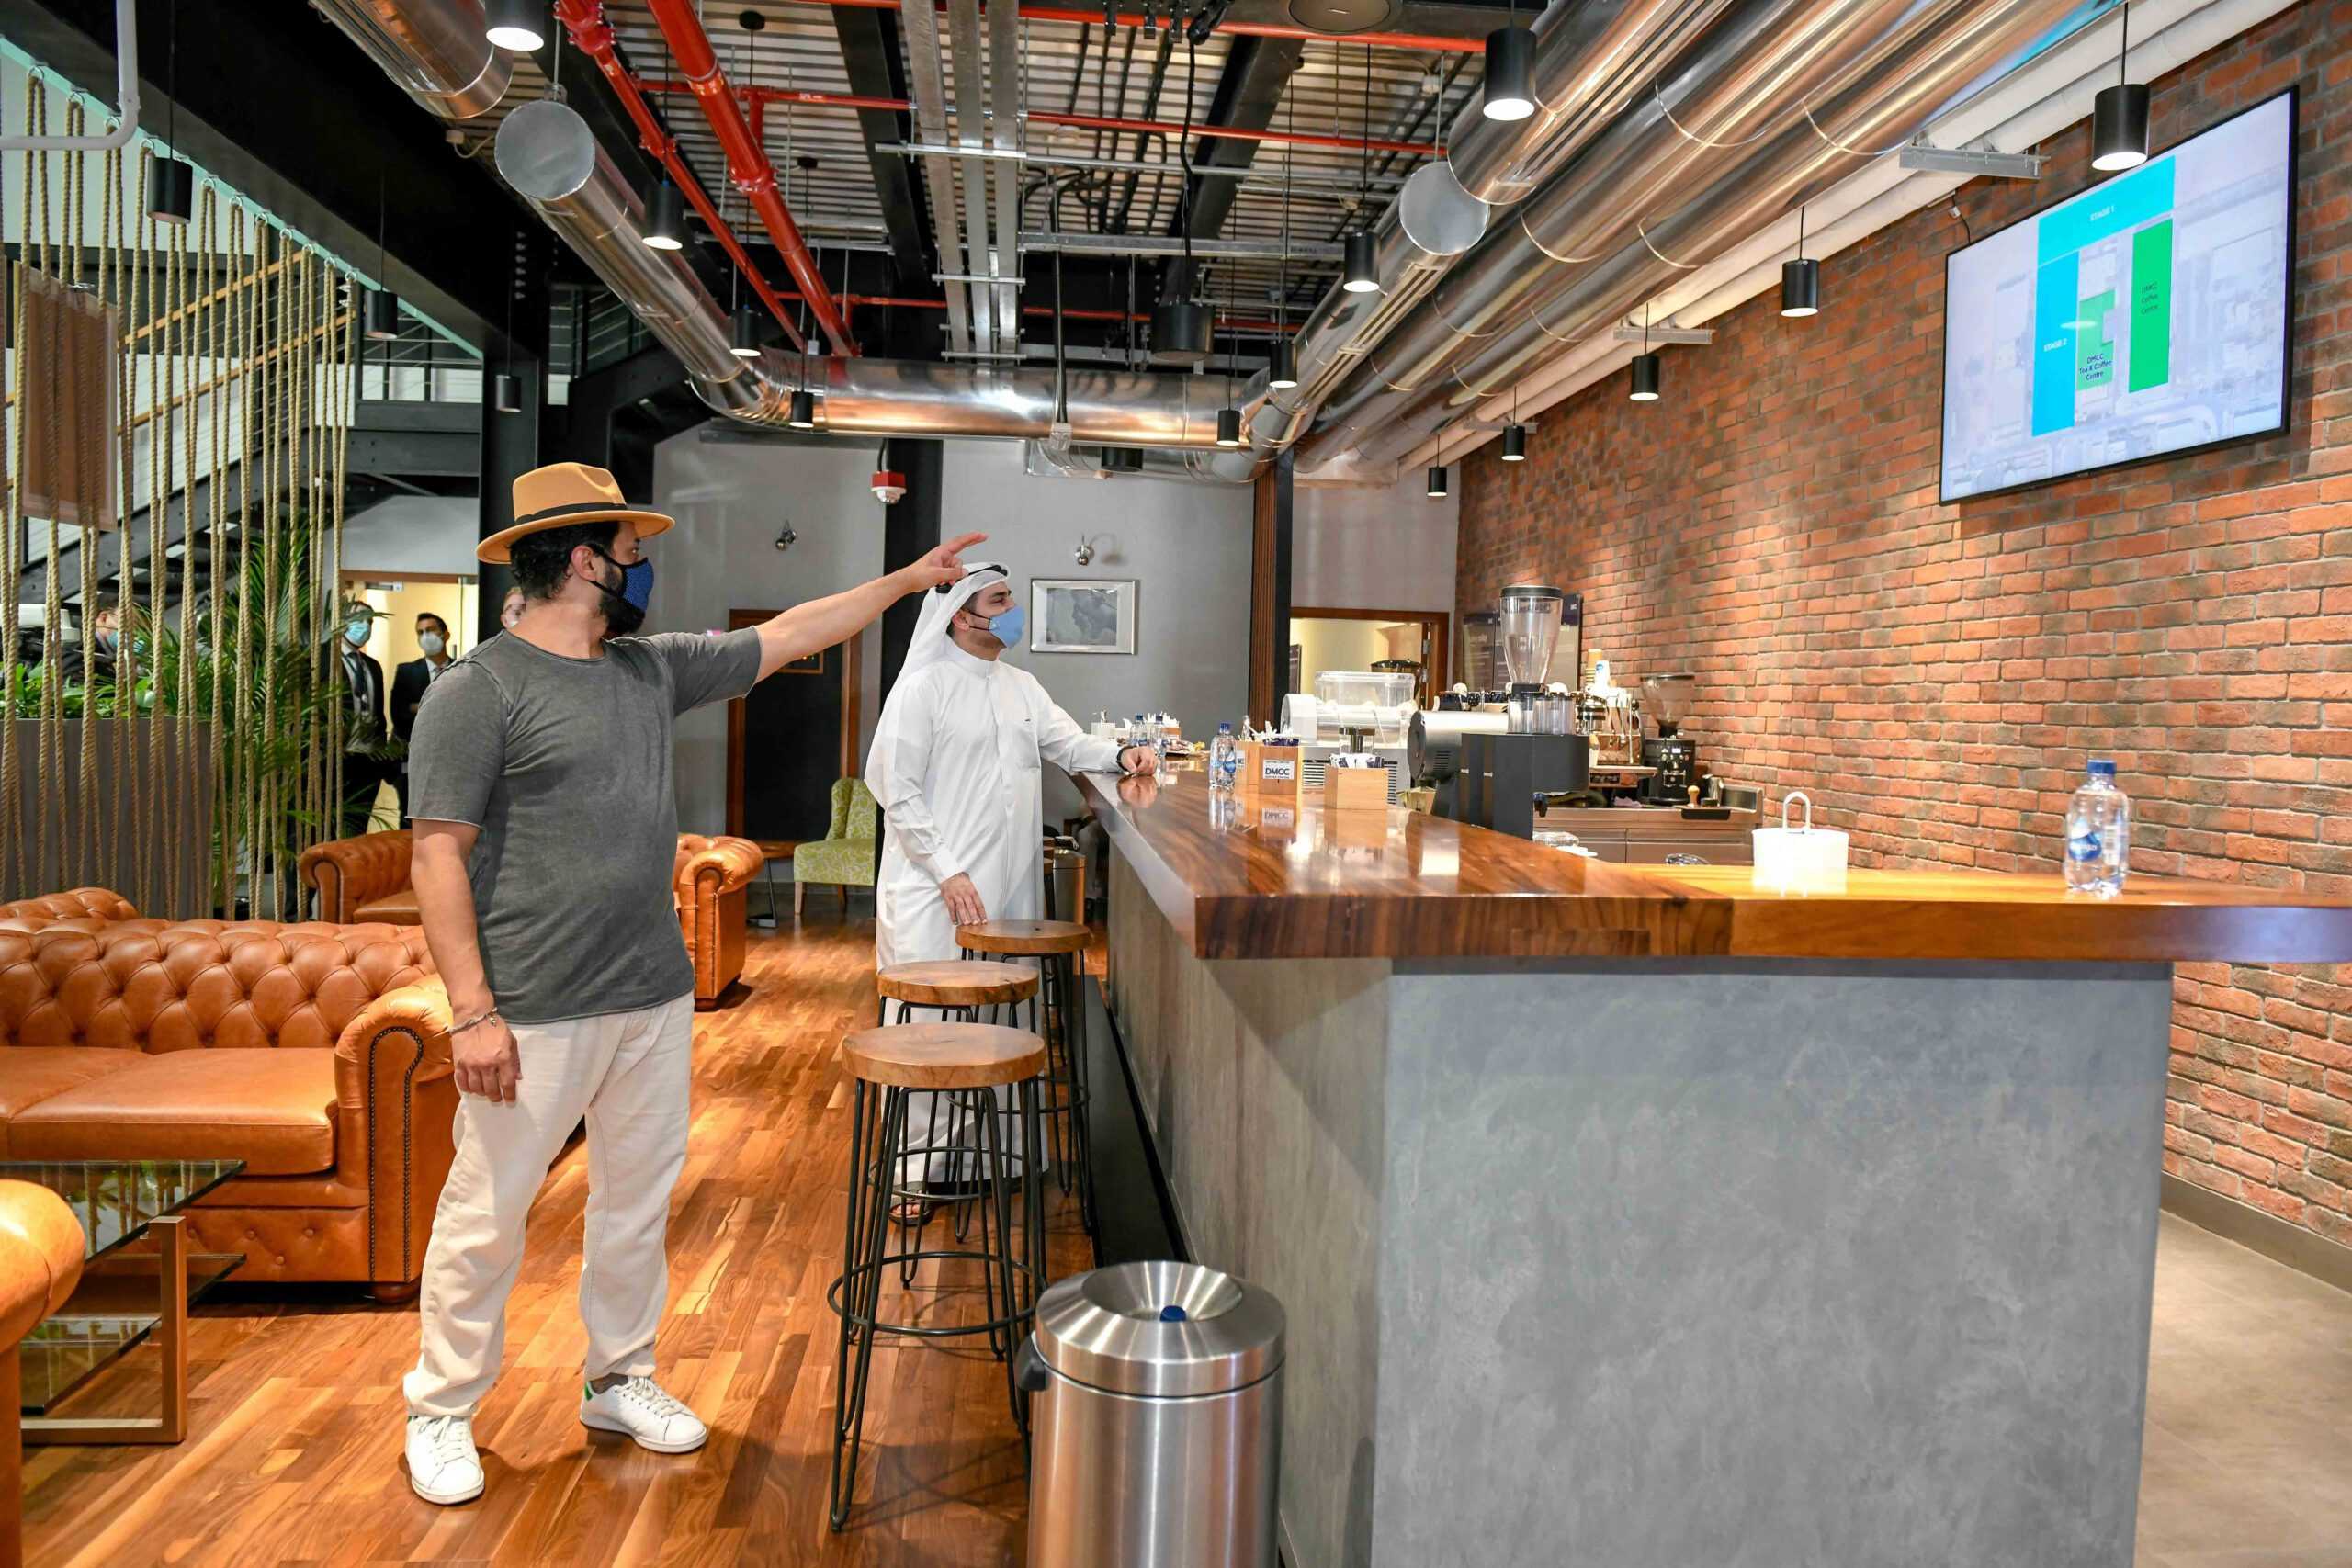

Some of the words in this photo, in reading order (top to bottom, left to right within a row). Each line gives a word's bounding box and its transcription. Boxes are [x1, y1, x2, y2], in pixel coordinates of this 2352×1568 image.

[2090, 207, 2109, 221] STAGE
[2086, 353, 2104, 365] DMCC
[2094, 359, 2112, 371] Coffee
[2086, 370, 2104, 381] Centre
[1264, 767, 1290, 776] DMCC
